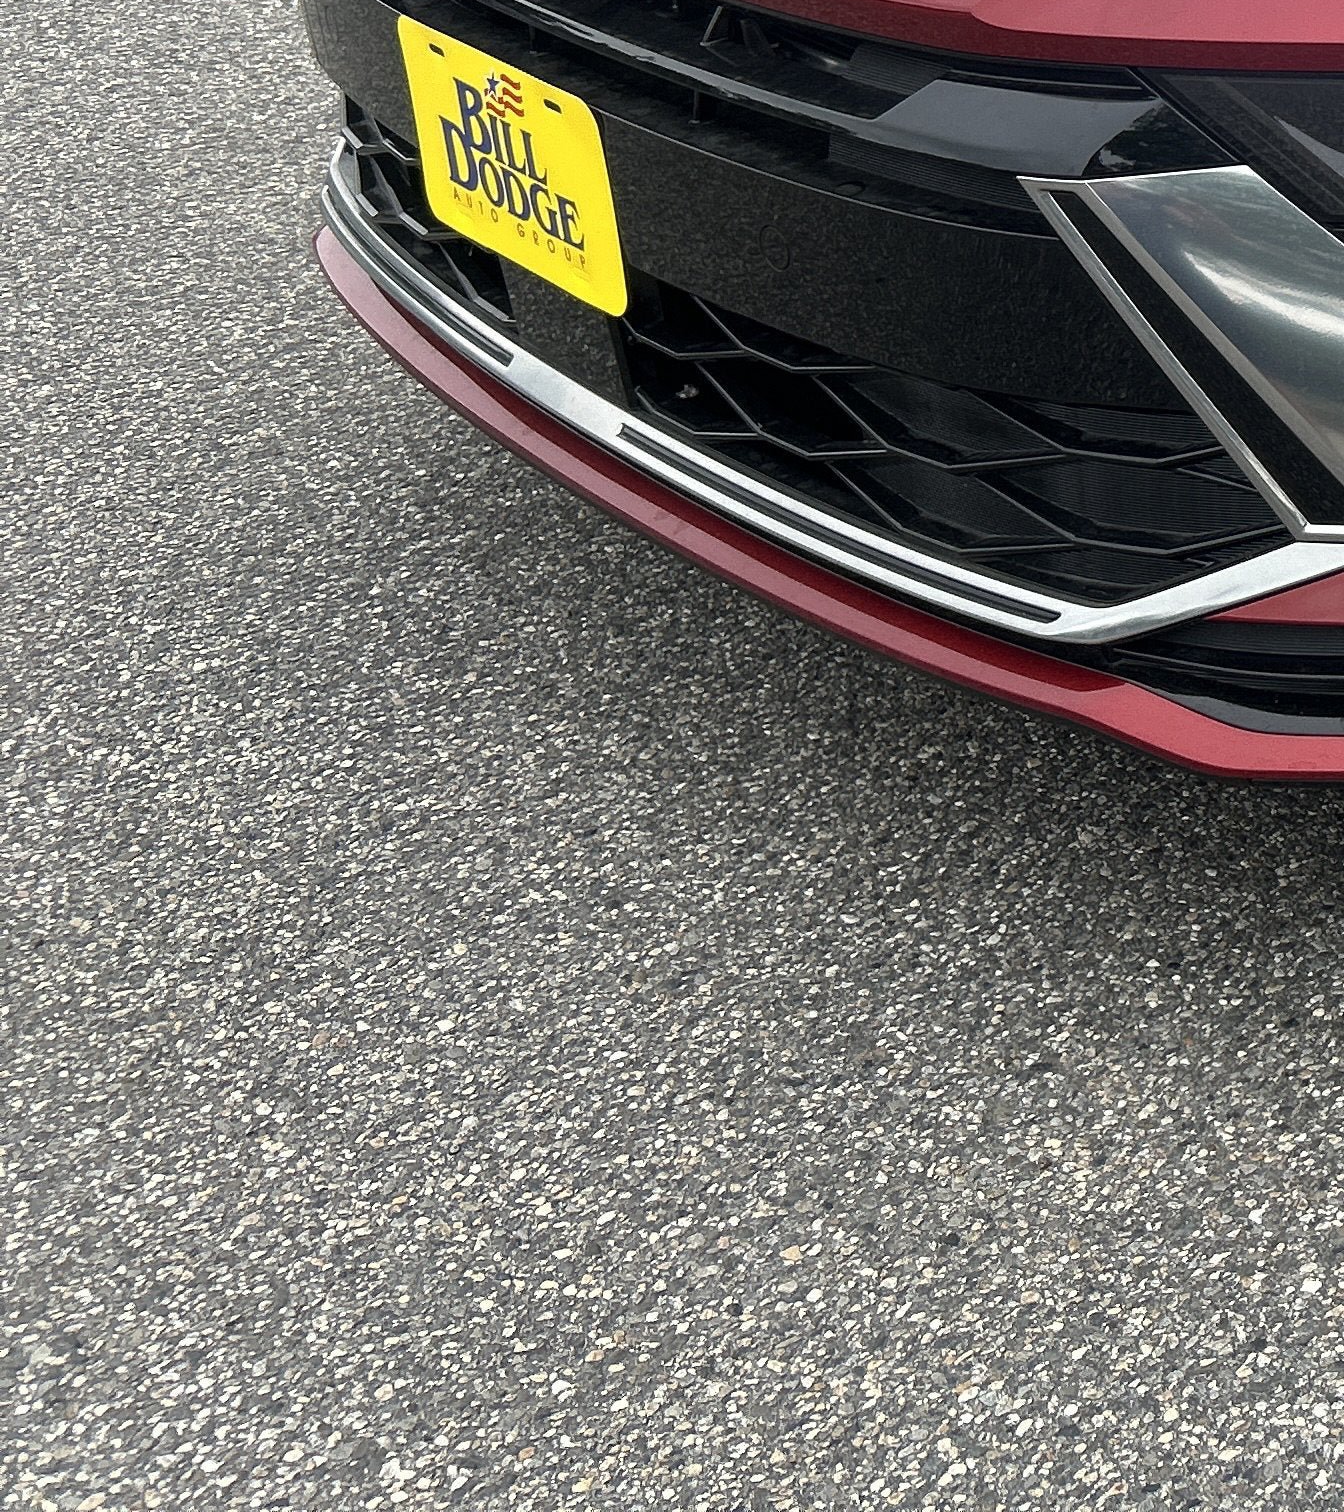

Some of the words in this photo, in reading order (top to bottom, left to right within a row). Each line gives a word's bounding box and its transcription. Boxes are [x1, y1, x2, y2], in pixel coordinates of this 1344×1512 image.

[438, 114, 585, 252] DODGE
[453, 76, 548, 186] BILL
[453, 187, 499, 223] AUTO
[516, 222, 586, 269] GROUP
